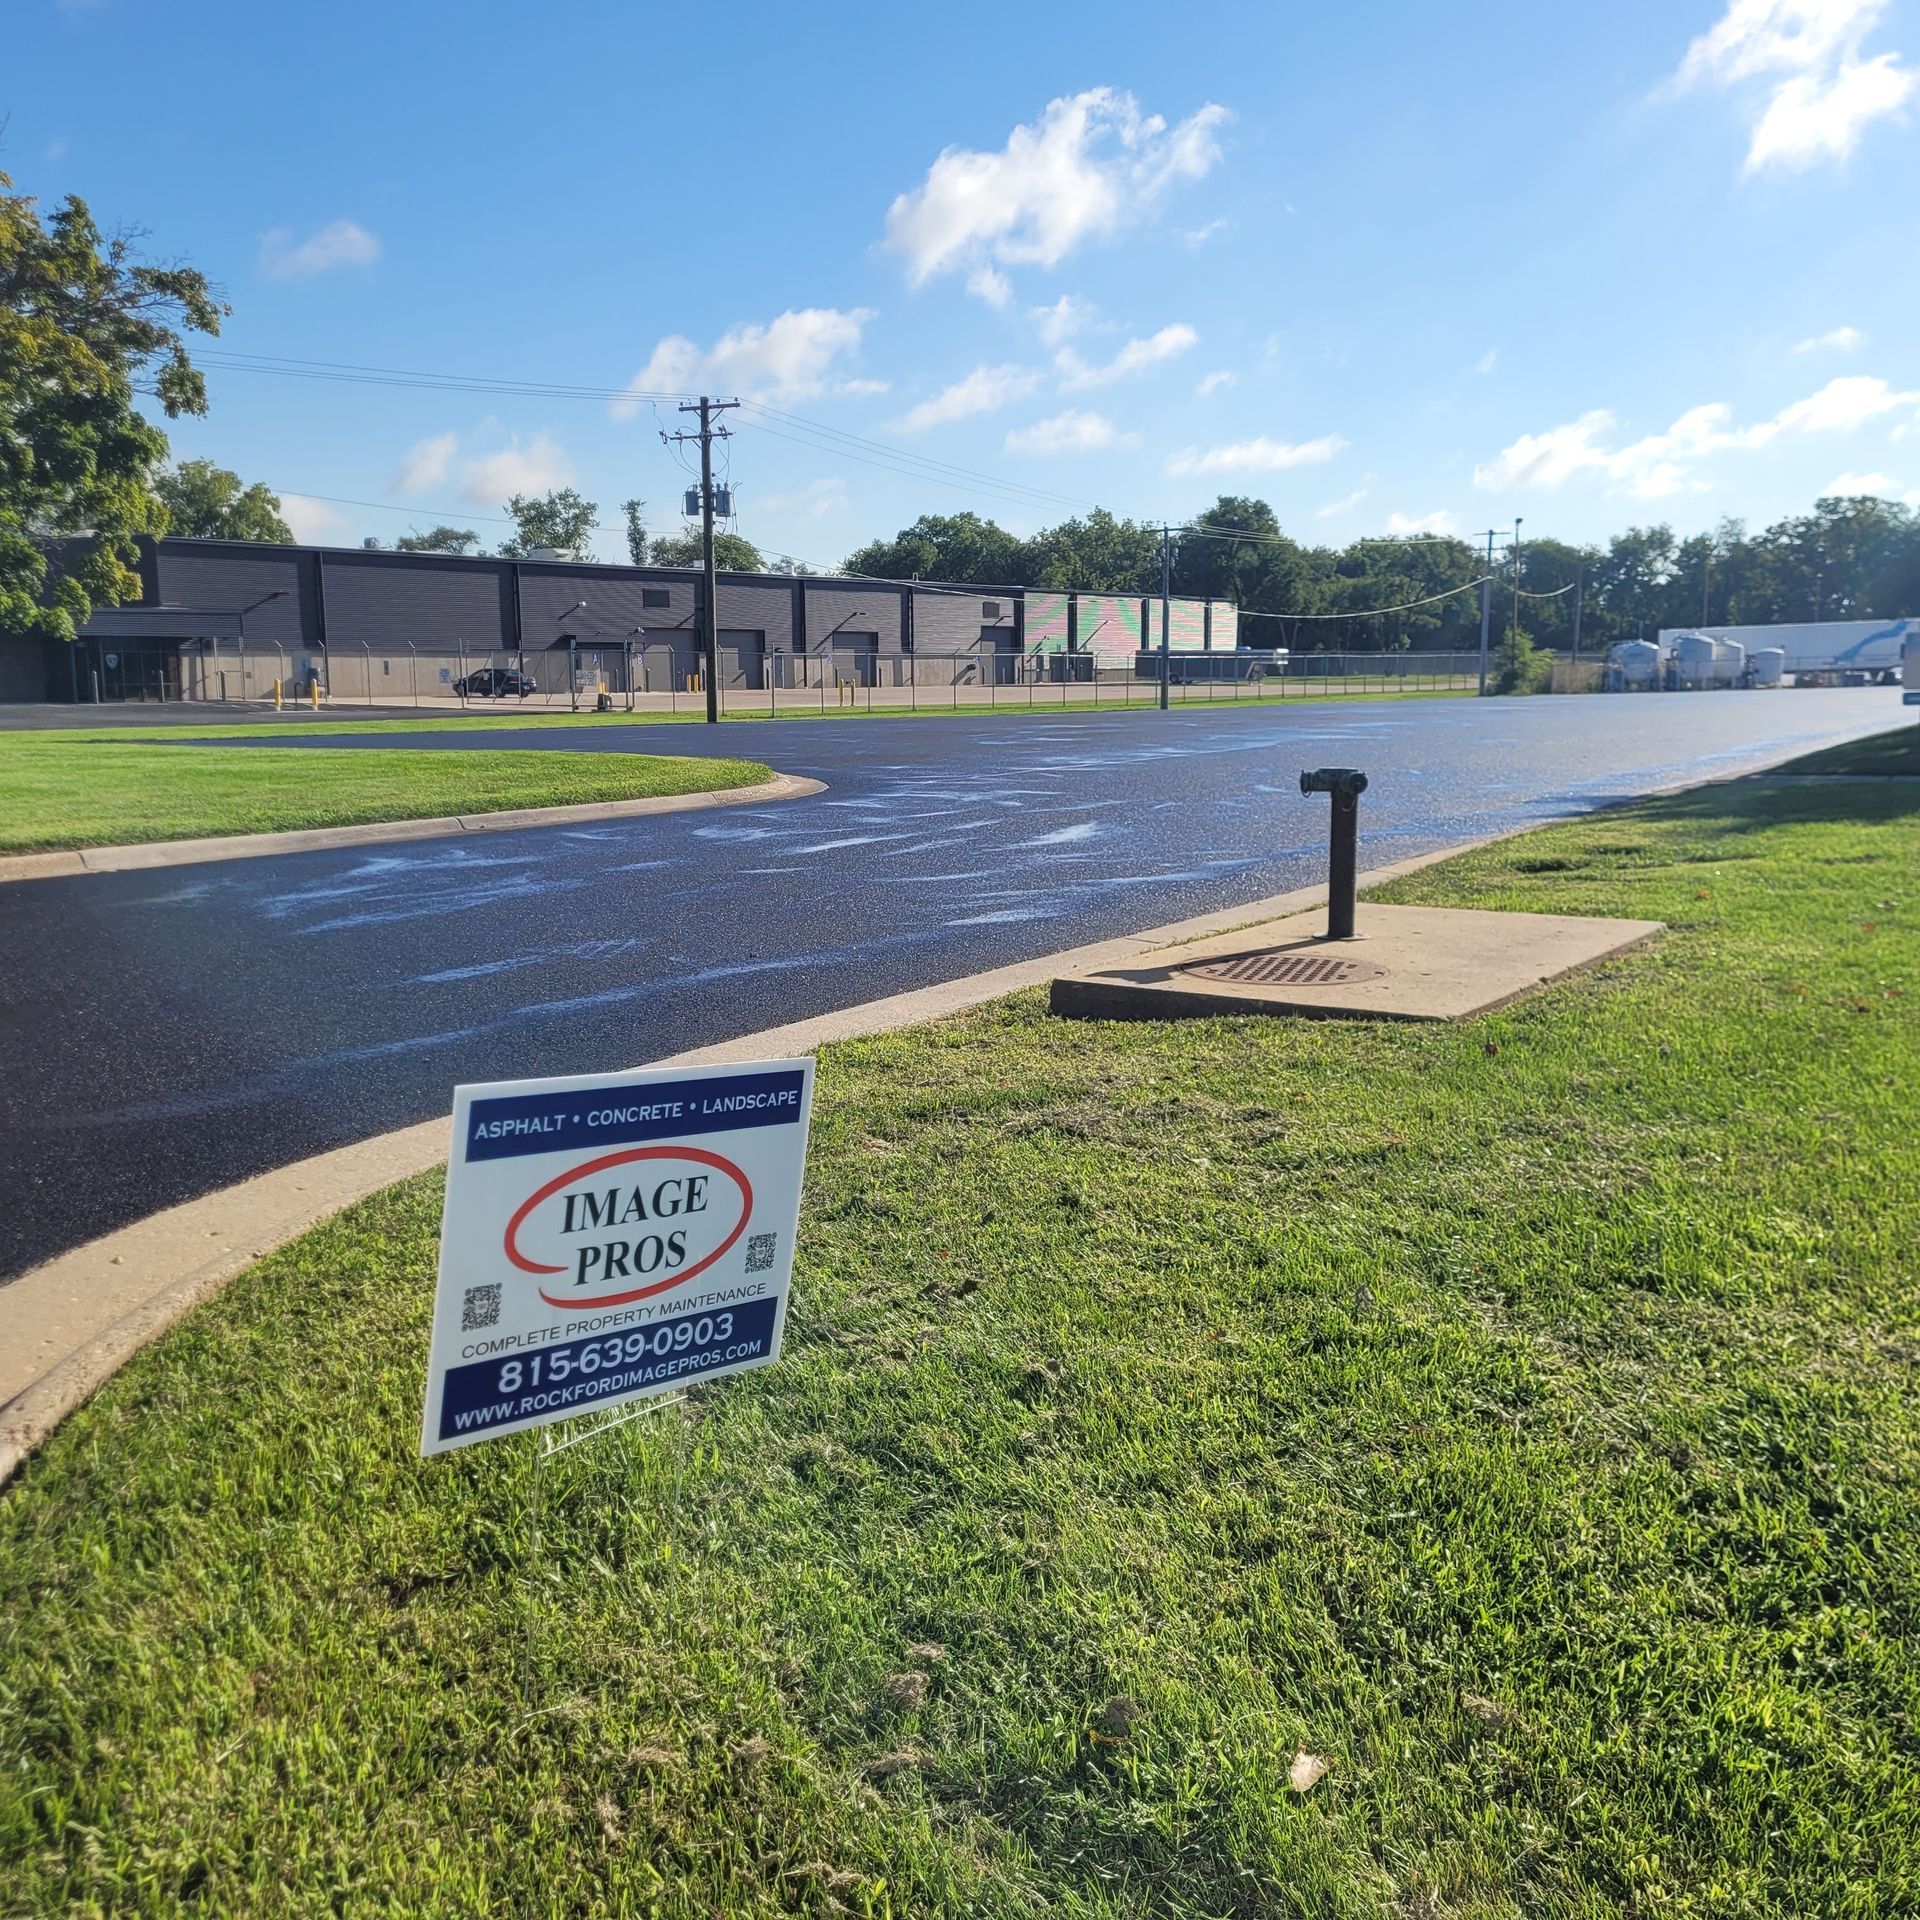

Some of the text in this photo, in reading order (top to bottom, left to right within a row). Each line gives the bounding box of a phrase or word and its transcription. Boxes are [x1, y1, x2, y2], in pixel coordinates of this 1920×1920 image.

[475, 1090, 798, 1141] ASPHALT CONCRETE LANDSCAPE
[560, 1175, 709, 1235] IMAGE
[574, 1230, 687, 1286] PROS
[462, 1282, 767, 1359] COMPLETE PROPERTY MAINTENANCE
[498, 1313, 734, 1394] 815-639-0903
[454, 1339, 762, 1430] WWW.ROCKFORDIMAGEPROS.COM
